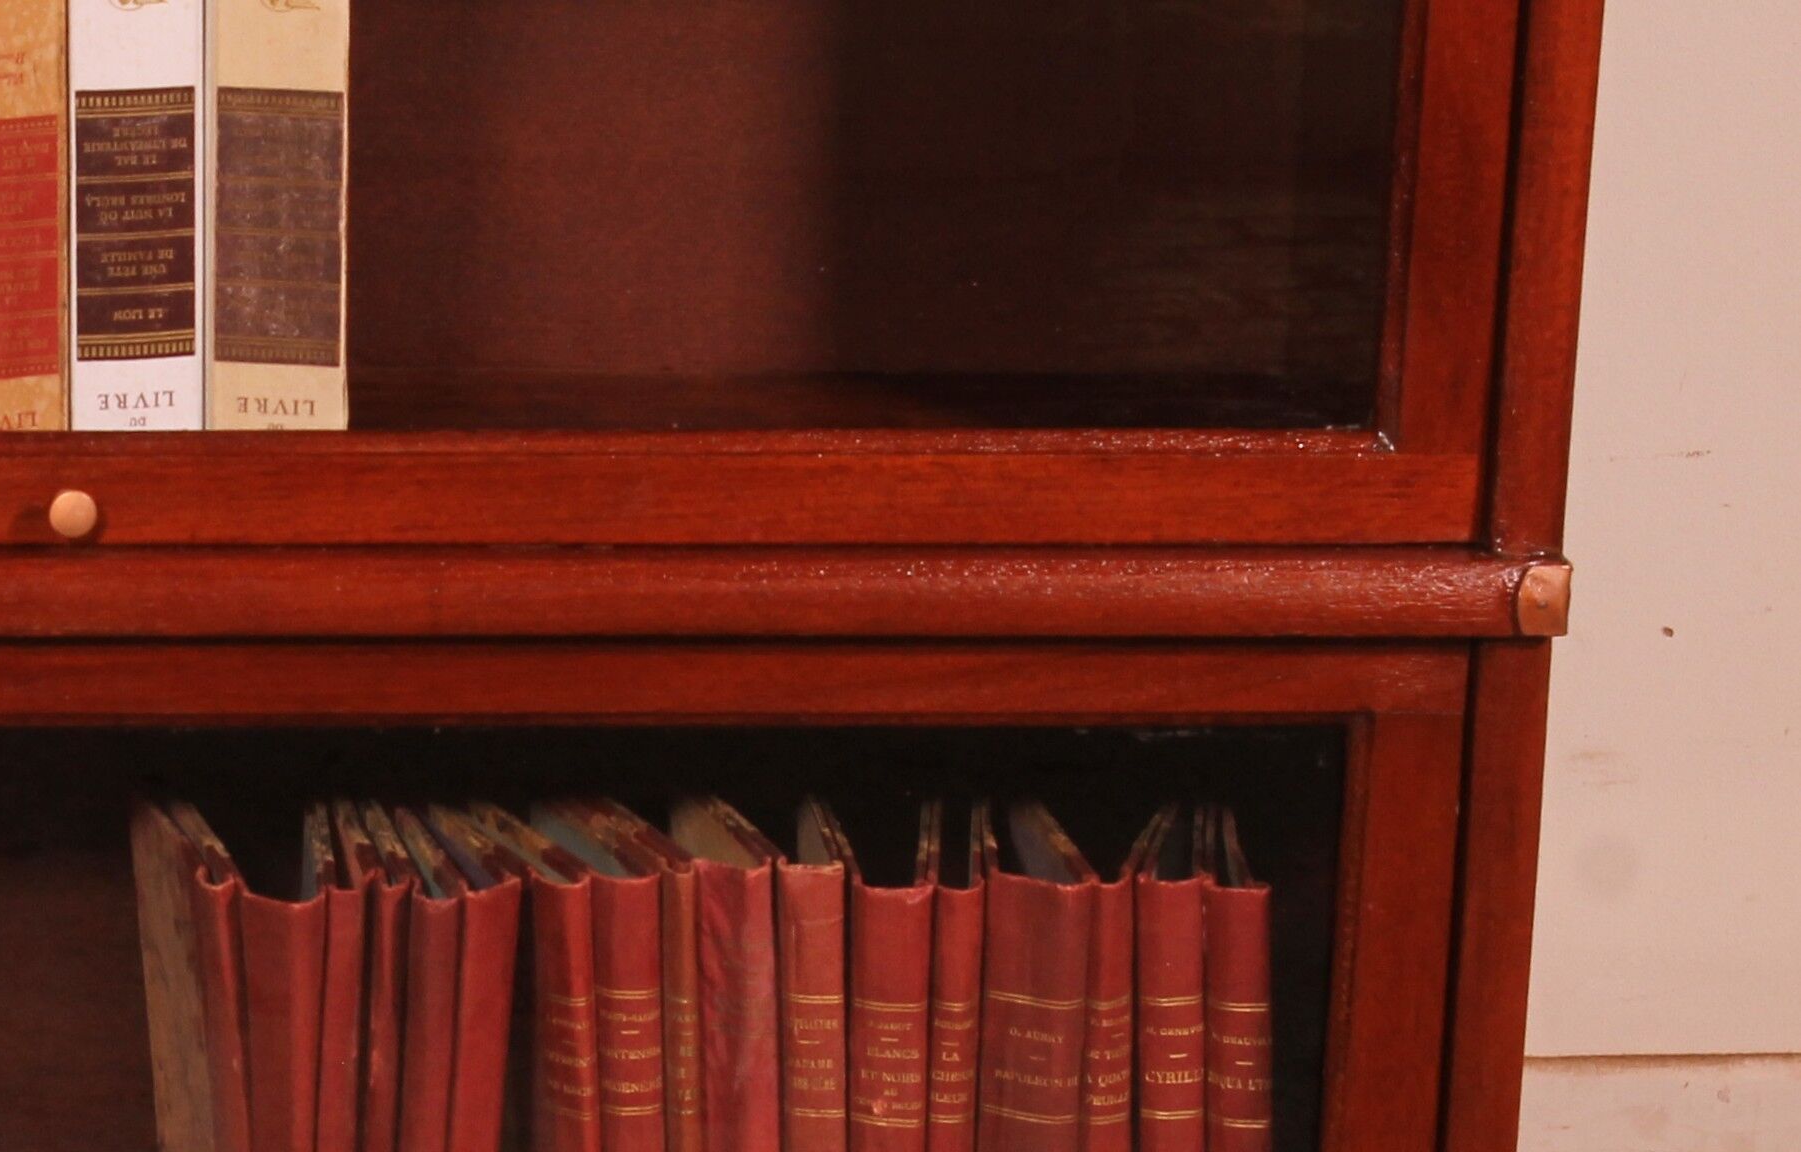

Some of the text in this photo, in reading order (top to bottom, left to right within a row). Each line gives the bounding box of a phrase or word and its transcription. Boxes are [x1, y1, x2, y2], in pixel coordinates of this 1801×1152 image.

[171, 137, 188, 149] DE
[142, 153, 158, 165] LE
[130, 192, 186, 205] LONDRES
[123, 208, 155, 221] NUIT
[157, 207, 174, 218] LA
[100, 248, 175, 263] DE FAMILLE
[141, 263, 167, 275] UNE
[114, 308, 163, 321] LE LION
[97, 391, 176, 410] LIVRE
[238, 396, 318, 416] LIVRE
[129, 416, 147, 426] DU
[942, 1051, 960, 1062] LA
